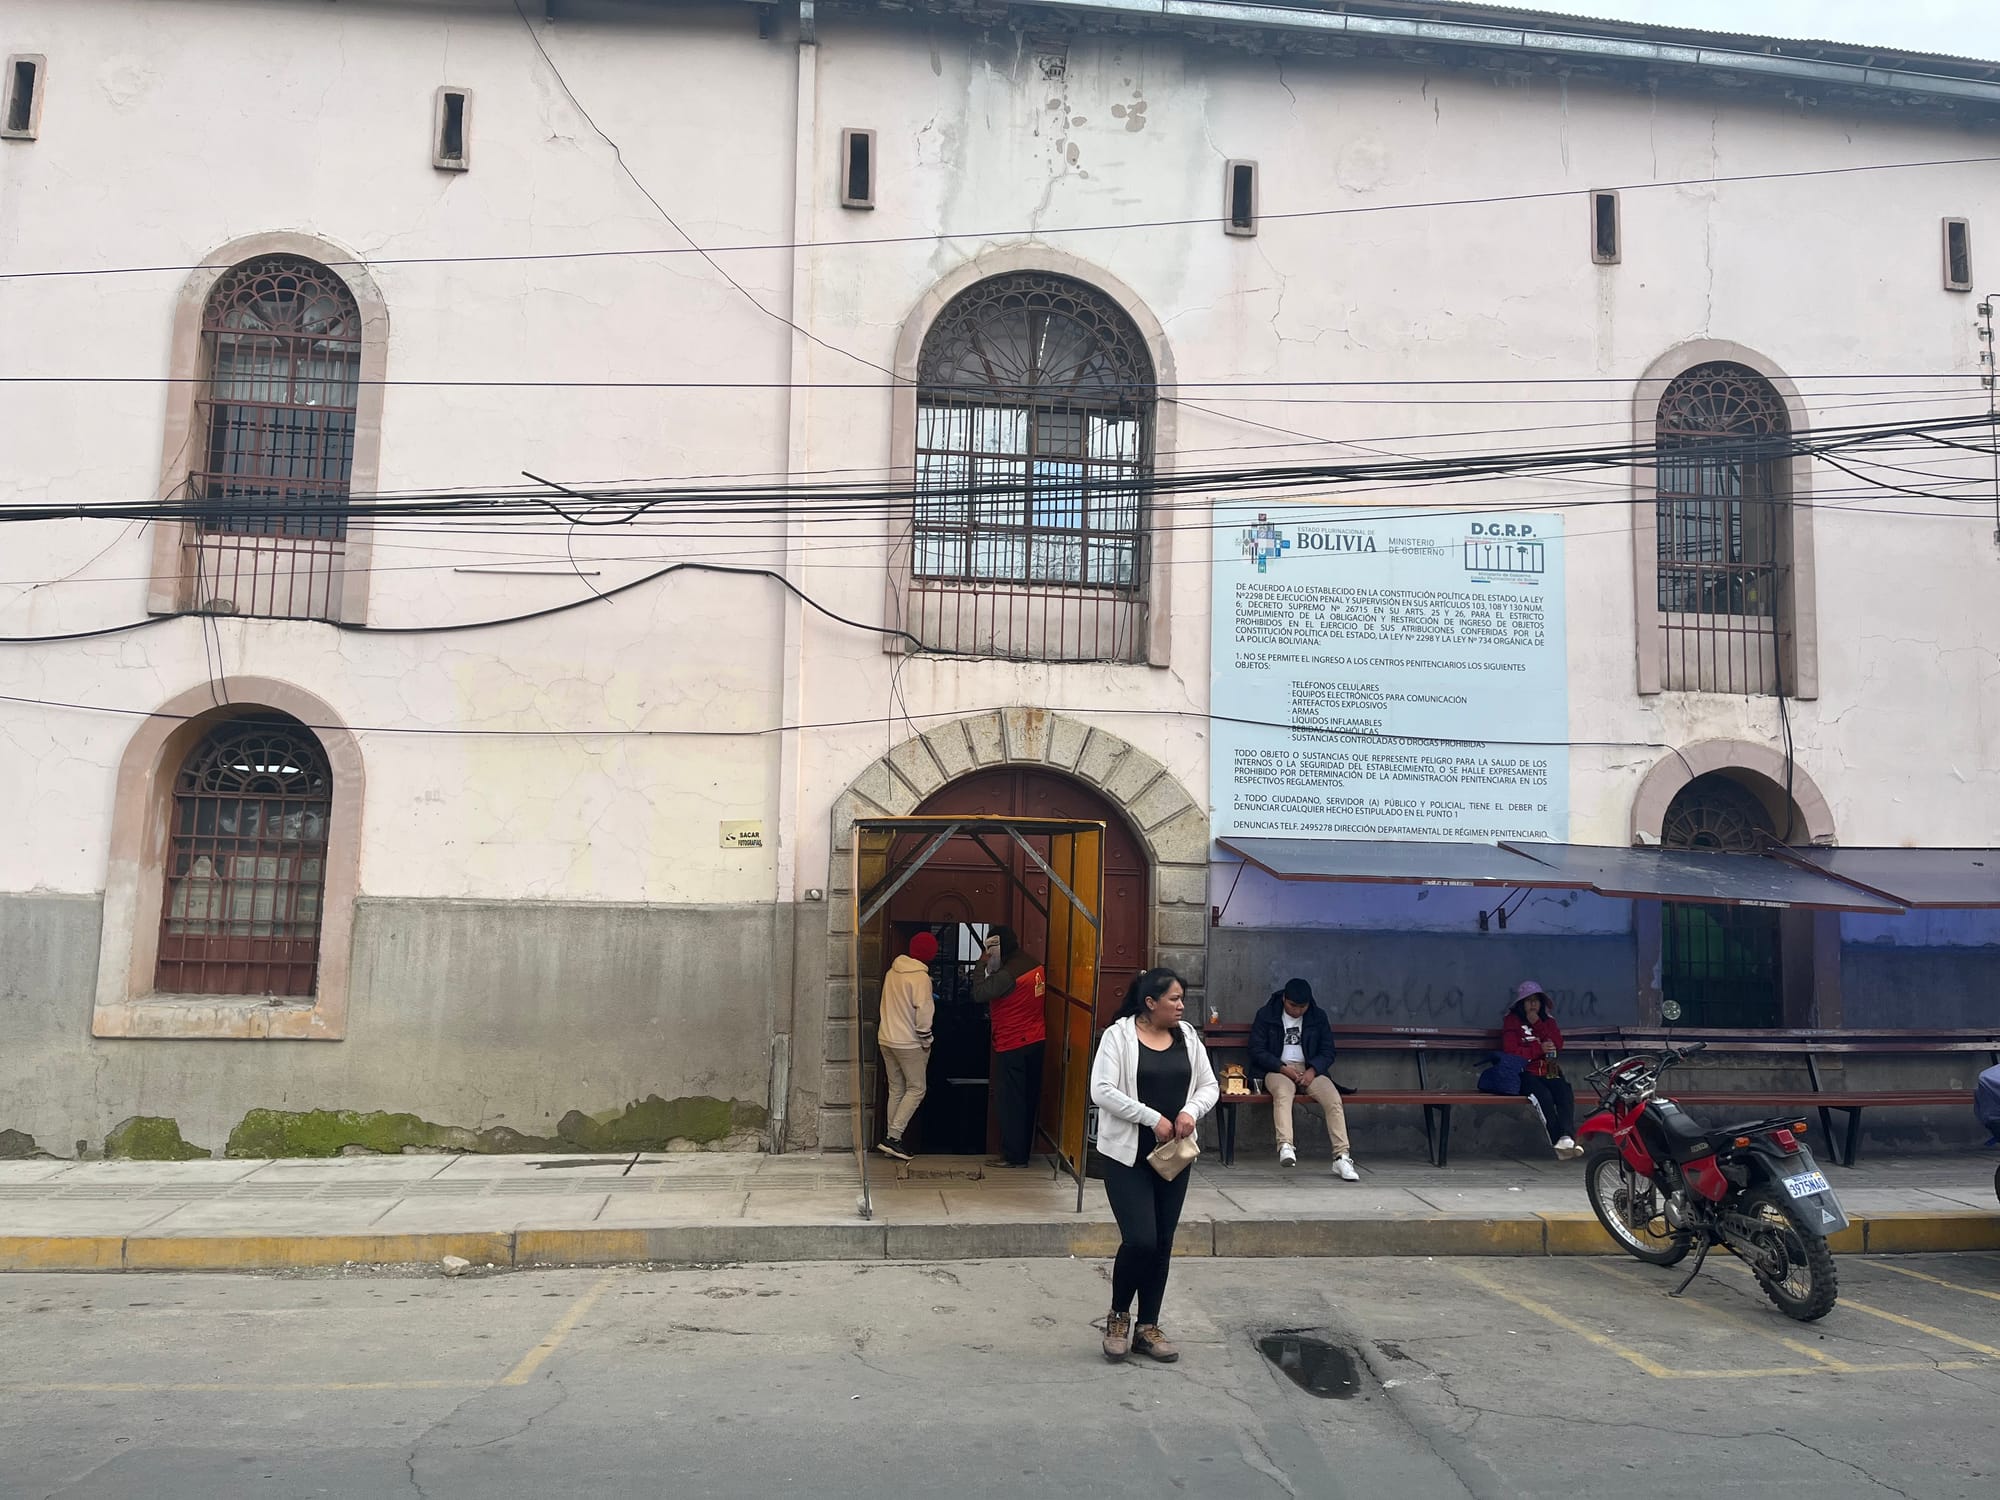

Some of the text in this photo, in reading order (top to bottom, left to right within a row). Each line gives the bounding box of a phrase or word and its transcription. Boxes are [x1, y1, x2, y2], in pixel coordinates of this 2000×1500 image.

[1471, 522, 1536, 537] D.G.R.P.
[1297, 532, 1376, 552] BOLIVIA
[1388, 537, 1434, 546] MINISTERIO
[1388, 546, 1444, 556] DE GOBIERNO
[1236, 582, 1543, 603] DE ACUERDO A LO ESTABLECIDO EN LA CONSTITUCIÓN POLÍTICA DEL ESTADO, LA LEY
[1248, 600, 1282, 609] DECRETO
[1288, 602, 1325, 611] SUPREMO
[1345, 605, 1367, 613] 26715
[1373, 606, 1383, 614] EN
[1389, 606, 1399, 614] SU
[1431, 608, 1440, 616] 25
[1454, 609, 1465, 617] 26,
[1471, 610, 1490, 618] PARA
[1495, 611, 1504, 619] EL
[1509, 611, 1544, 620] ESTRICTO
[1235, 608, 1294, 618] CUMPLIMIENTO
[1299, 611, 1309, 619] DE
[1315, 612, 1324, 620] LA
[1329, 612, 1376, 622] OBLIGACIÓN
[1390, 615, 1438, 625] RESTRICCIÓN
[1443, 617, 1454, 625] DE
[1459, 618, 1491, 627] INGRESO
[1496, 619, 1506, 628] DE
[1511, 620, 1544, 629] OBJETOS
[1235, 617, 1282, 626] PROHIBIDOS
[1288, 619, 1299, 627] EN
[1305, 620, 1314, 628] EL
[1320, 621, 1357, 630] EJERCICIO
[1363, 622, 1374, 630] DE
[1380, 623, 1395, 631] SUS
[1401, 624, 1454, 634] ATRIBUCIONES
[1460, 627, 1507, 636] CONFERIDAS
[1513, 629, 1528, 637] POR
[1234, 660, 1270, 669] OBJETOS:
[1243, 652, 1255, 660] NO
[1257, 652, 1266, 661] SE
[1267, 653, 1299, 662] PERMITE
[1301, 654, 1309, 662] EL
[1311, 655, 1345, 664] INGRESO
[1346, 656, 1352, 664] A
[1353, 657, 1368, 665] LOS
[1369, 657, 1404, 666] CENTROS
[1405, 659, 1466, 669] PENITENCIARIOS
[1467, 661, 1482, 669] LOS
[1483, 662, 1525, 671] SIGUIENTES
[1291, 680, 1379, 691] TELÉFONOS CELULARES
[1291, 698, 1387, 709] ARTEFACTOS EXPLOSIVOS
[1292, 689, 1467, 703] EQUIPOS ELECTRÓNICOS PARA COMUNICACIÓN
[1291, 707, 1319, 715] ARMAS
[1292, 715, 1382, 727] LÍQUIDOS INFLAMABLES
[1291, 733, 1338, 743] SUSTANCIAS
[1340, 735, 1397, 745] CONTROLADAS
[1406, 738, 1438, 746] DROGAS
[1440, 739, 1486, 748] PROHIBIDAS
[1234, 748, 1257, 757] TODO
[1259, 749, 1289, 758] OBJETO
[1292, 751, 1299, 759] O
[1302, 751, 1349, 761] SUSTANCIAS
[1352, 753, 1368, 761] QUE
[1371, 754, 1417, 763] REPRESENTE
[1421, 756, 1452, 764] PELIGRO
[1455, 757, 1475, 765] PARA
[1491, 758, 1516, 766] SALUD
[1519, 759, 1529, 767] DE
[1532, 759, 1547, 767] LOS
[1234, 757, 1272, 766] INTERNOS
[1276, 759, 1282, 767] O
[1286, 759, 1296, 767] LA
[1300, 760, 1344, 769] SEGURIDAD
[1348, 762, 1362, 770] DEL
[1439, 765, 1445, 773] O
[1449, 765, 1457, 773] SE
[1461, 766, 1485, 774] HALLE
[1489, 767, 1547, 776] EXPRESAMENTE
[1234, 766, 1547, 785] PROHIBIDO POR DETERMINACIÓN DE LA ADMINISTRACIÓN PENITENCIARIA EN LOS
[1234, 775, 1344, 787] RESPECTIVOS REGLAMENTOS.
[1233, 802, 1457, 818] DENUNCIAR CUALQUIER HECHO ESTIPULADO EN EL PUNTO 1
[1244, 793, 1267, 802] TODO
[1271, 794, 1321, 804] CIUDADANO,
[1326, 796, 1364, 806] SERVIDOR
[1368, 798, 1379, 806] (A)
[1384, 798, 1416, 808] PÚBLICO
[1420, 800, 1425, 808] Y
[1468, 801, 1490, 810] TIENE
[1494, 802, 1503, 810] EL
[1508, 802, 1532, 811] DEBER
[1537, 803, 1547, 811] DE
[1233, 820, 1278, 829] DENUNCIAS
[1300, 822, 1332, 831] 2495278
[1334, 823, 1375, 833] DIRECCIÓN
[1377, 825, 1441, 835] DEPARTAMENTAL
[1442, 827, 1452, 835] DE
[1454, 827, 1488, 836] RÉGIMEN
